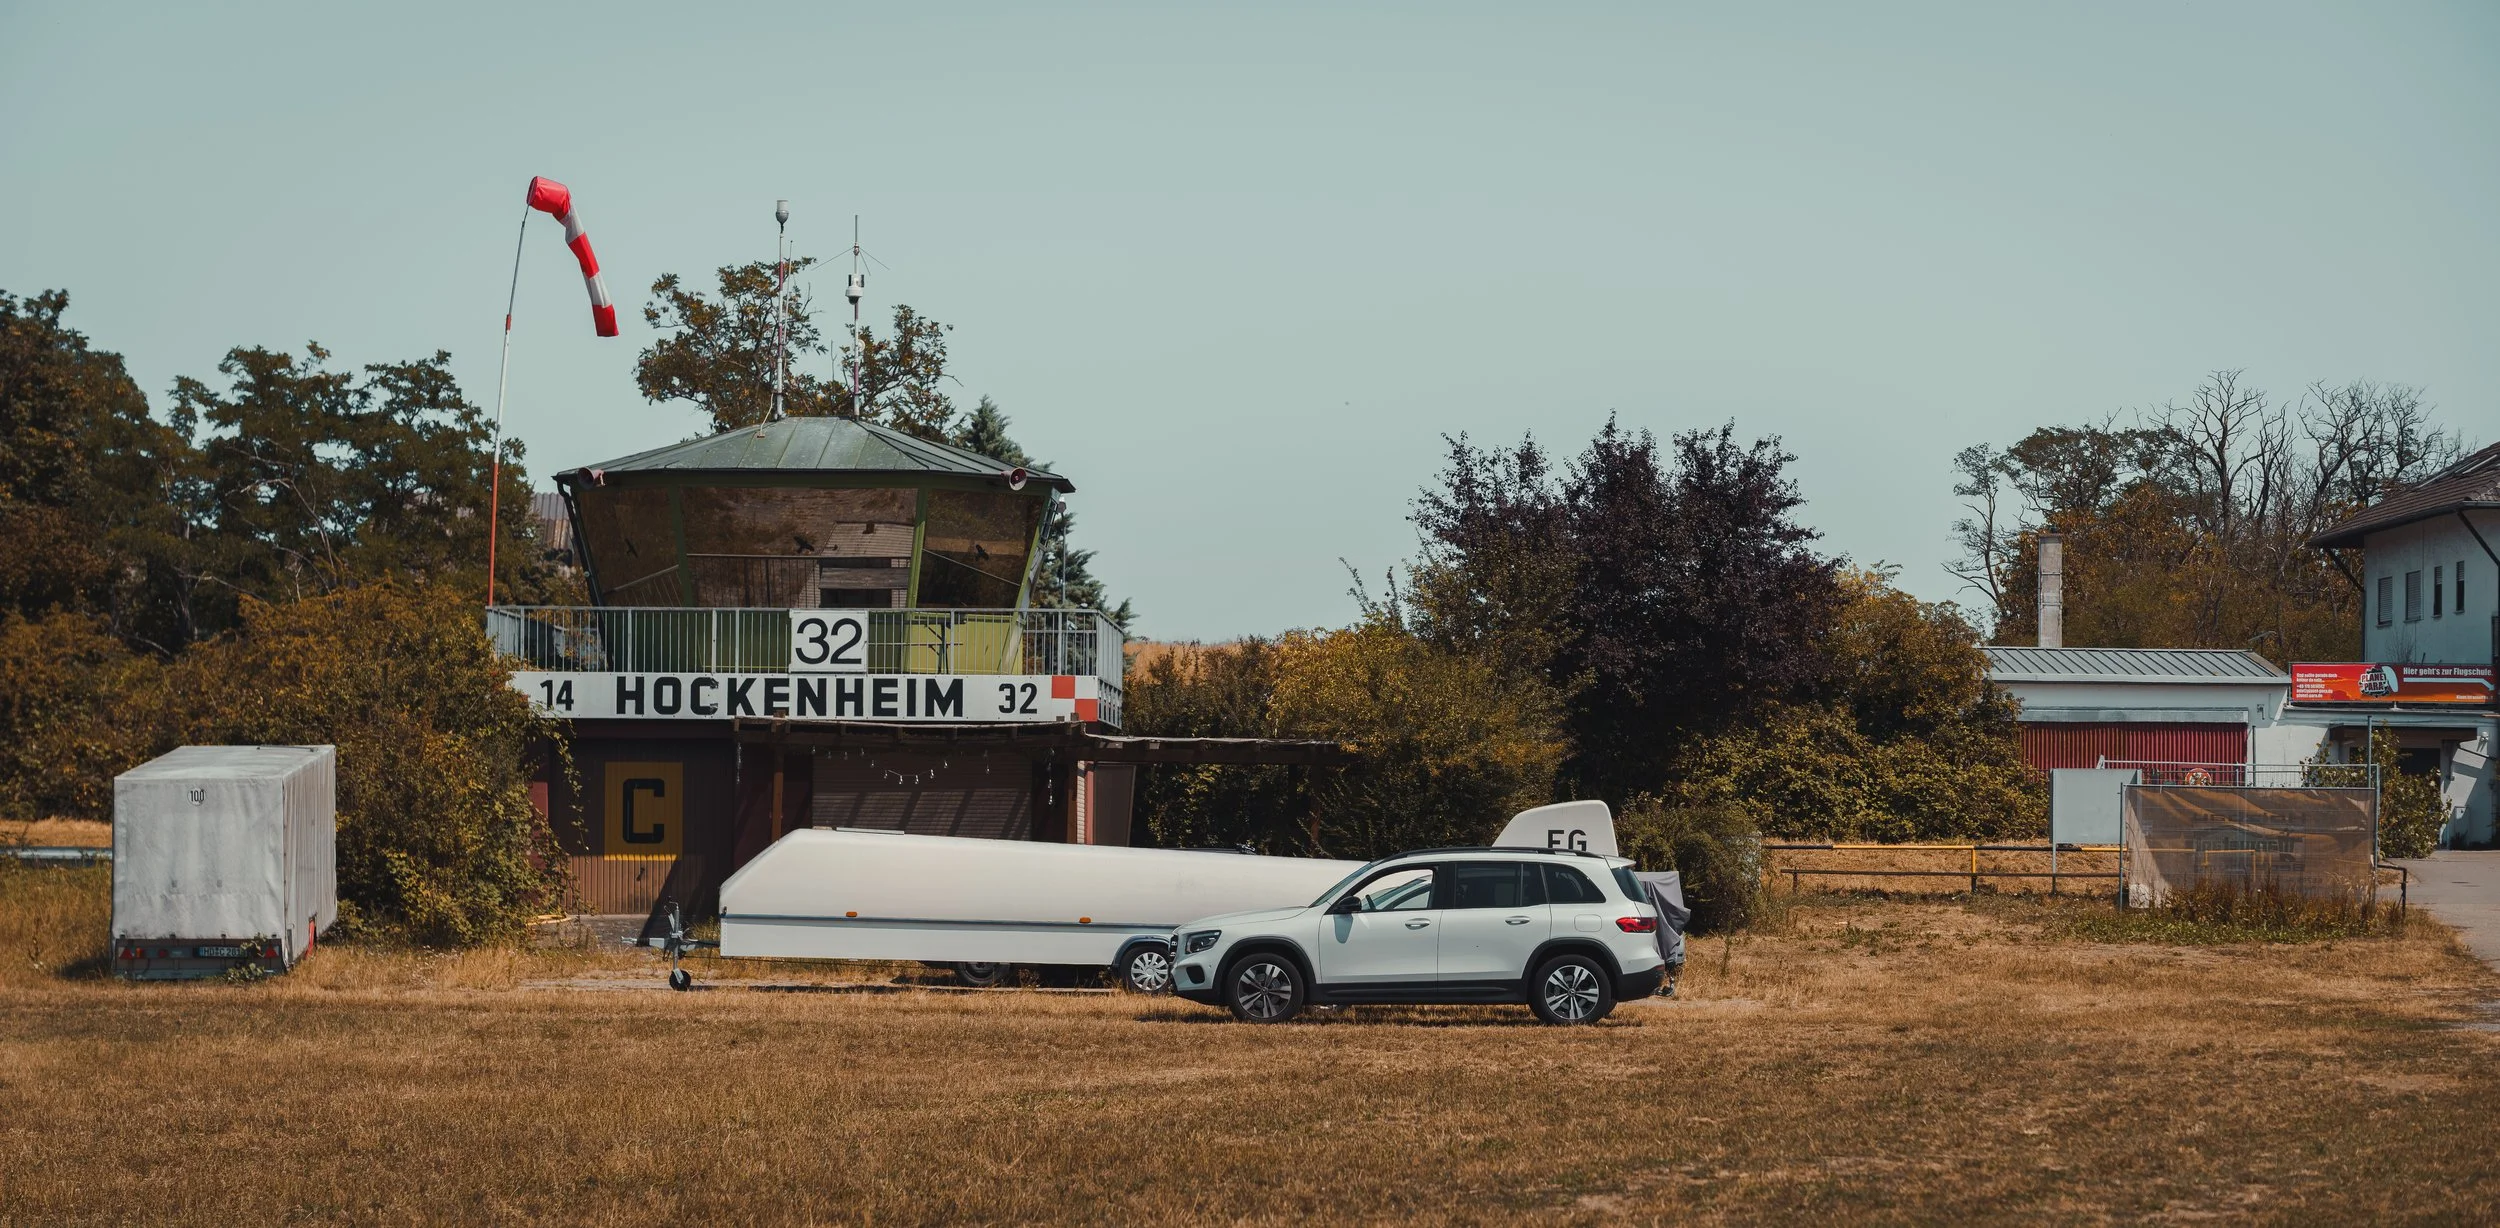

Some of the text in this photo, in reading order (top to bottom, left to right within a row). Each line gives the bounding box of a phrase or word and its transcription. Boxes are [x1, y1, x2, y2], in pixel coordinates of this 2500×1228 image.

[796, 617, 863, 665] 32
[2361, 673, 2387, 682] PLANE
[2403, 667, 2418, 675] Hier
[2419, 668, 2441, 676] geht's
[2453, 668, 2494, 676] Flugschule.
[2364, 682, 2384, 691] PARA
[540, 676, 1038, 716] 14 HOCKENHEIM 32
[190, 789, 205, 802] 100
[623, 778, 665, 844] C
